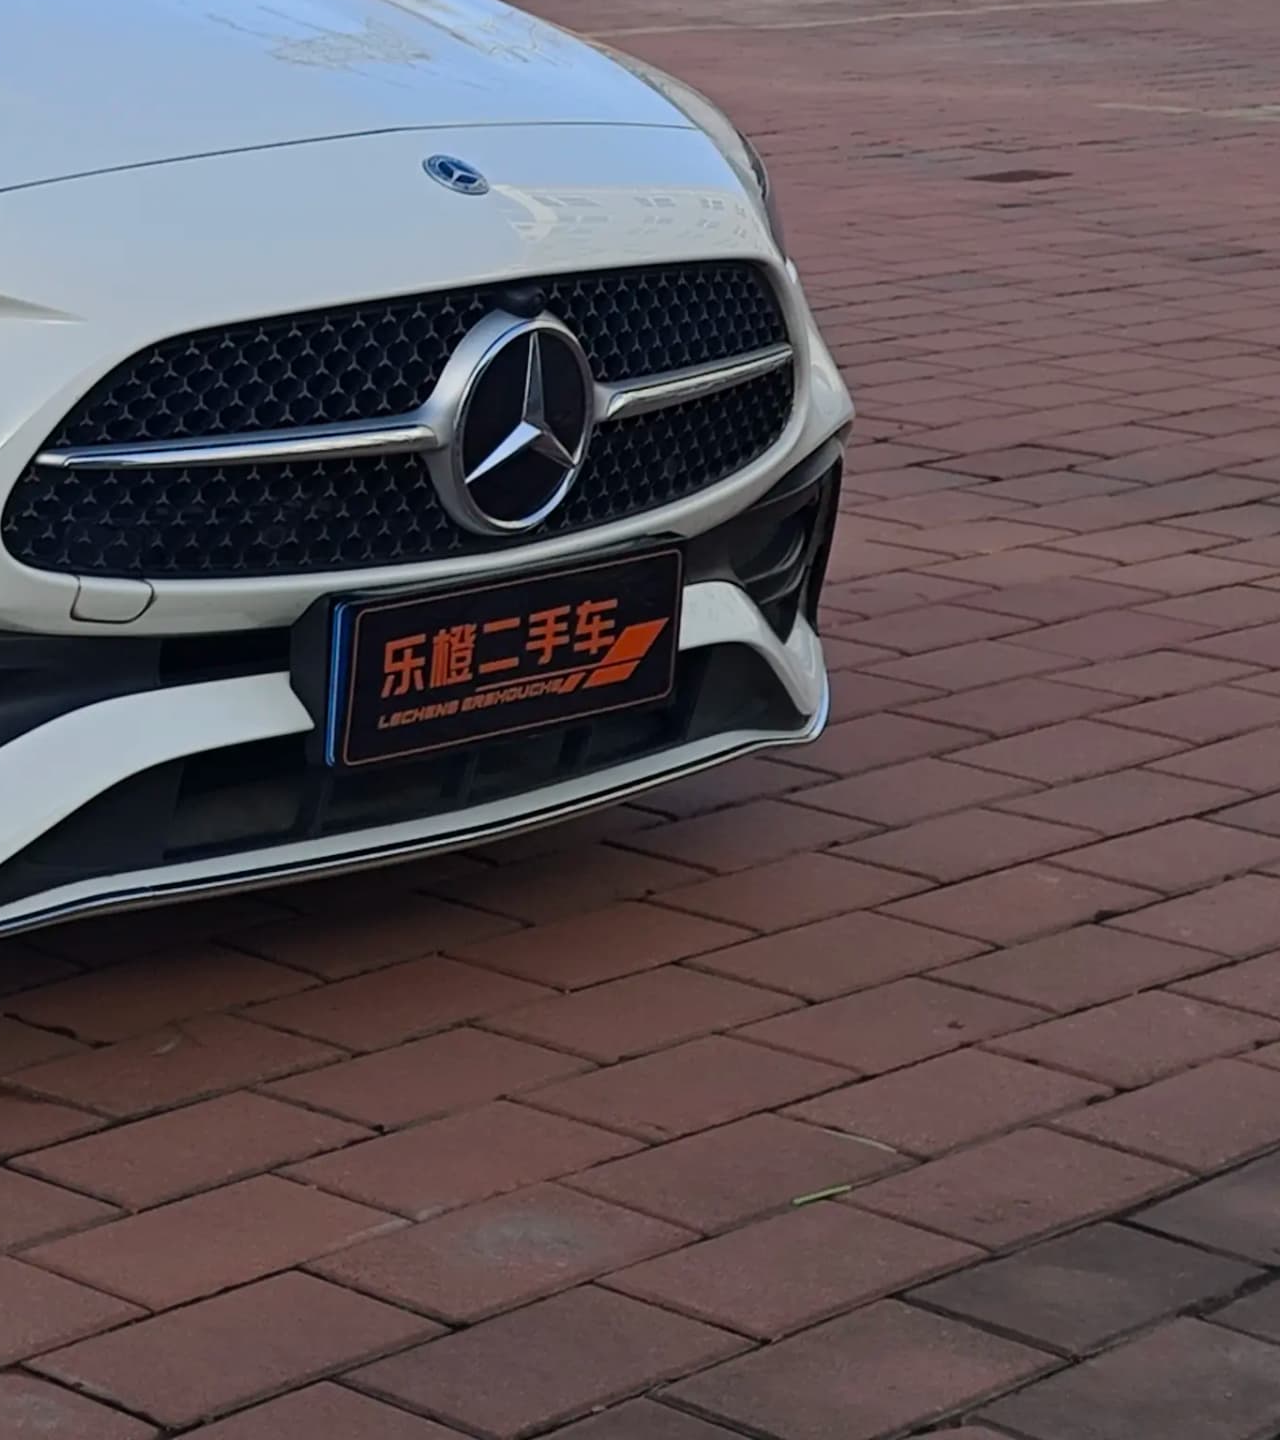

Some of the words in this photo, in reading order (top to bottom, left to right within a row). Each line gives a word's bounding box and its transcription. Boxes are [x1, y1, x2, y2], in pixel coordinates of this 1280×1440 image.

[381, 599, 618, 698] 乐橙二手车
